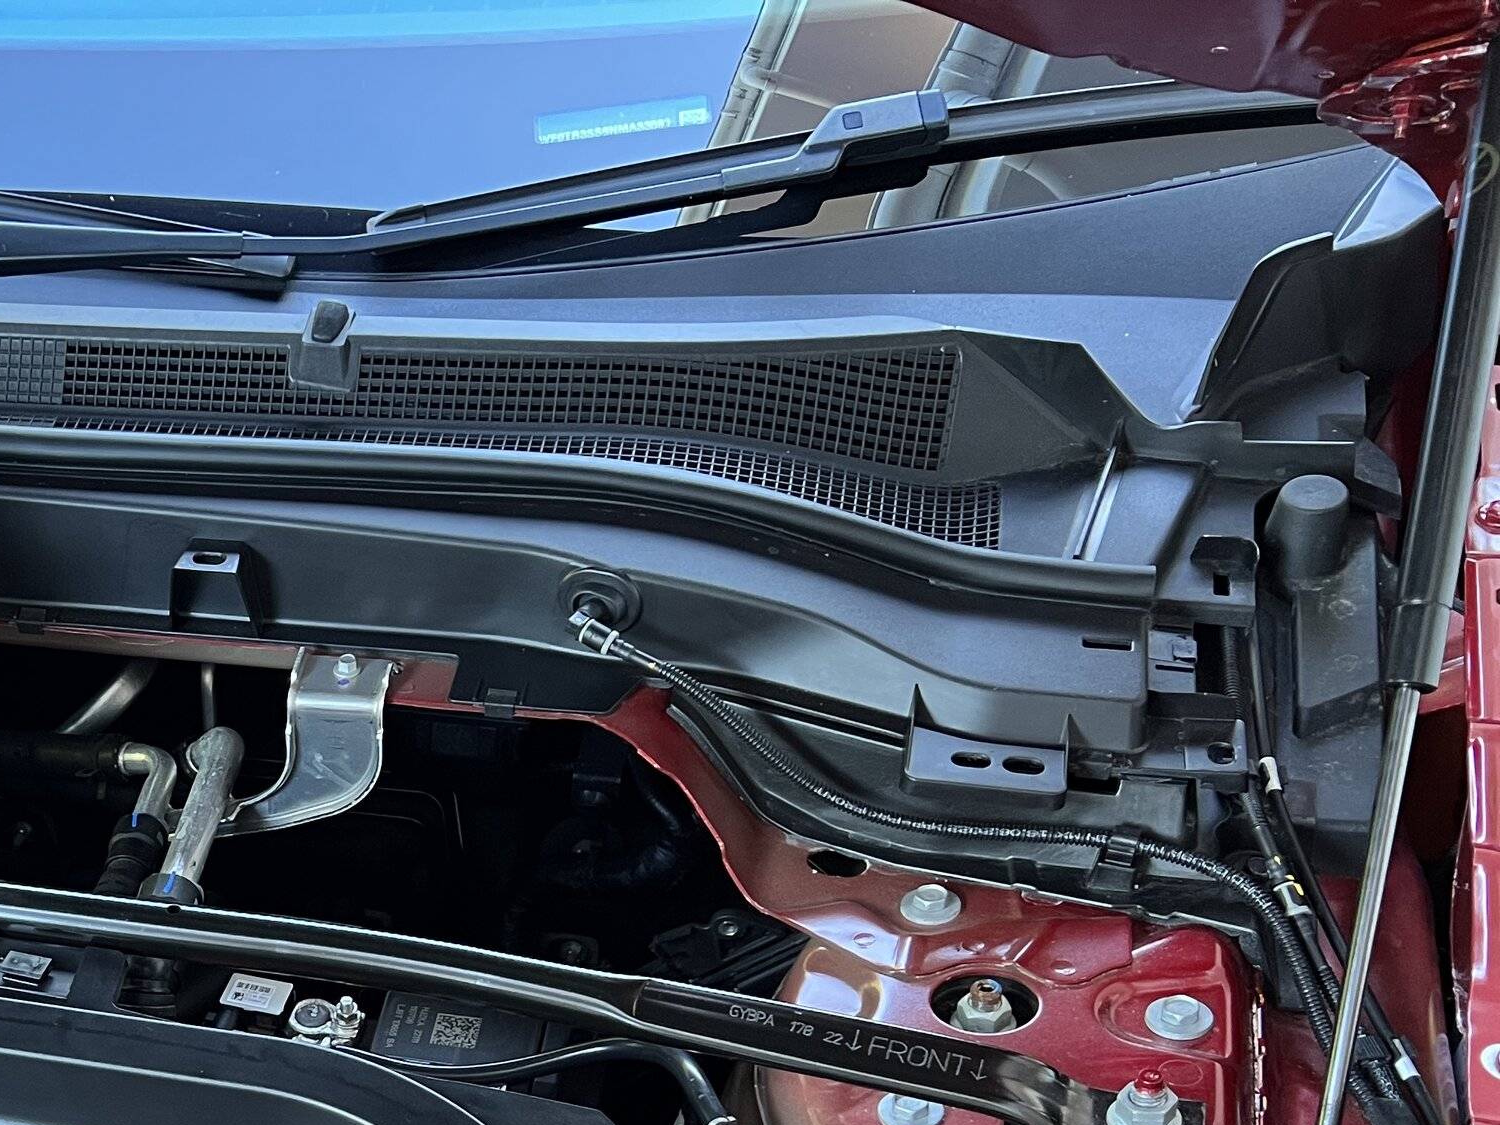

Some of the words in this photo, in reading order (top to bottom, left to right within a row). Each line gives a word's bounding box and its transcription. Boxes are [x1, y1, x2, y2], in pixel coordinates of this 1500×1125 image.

[728, 1003, 775, 1027] GYBPA
[822, 1030, 844, 1046] 22
[867, 1034, 971, 1076] FRONT
